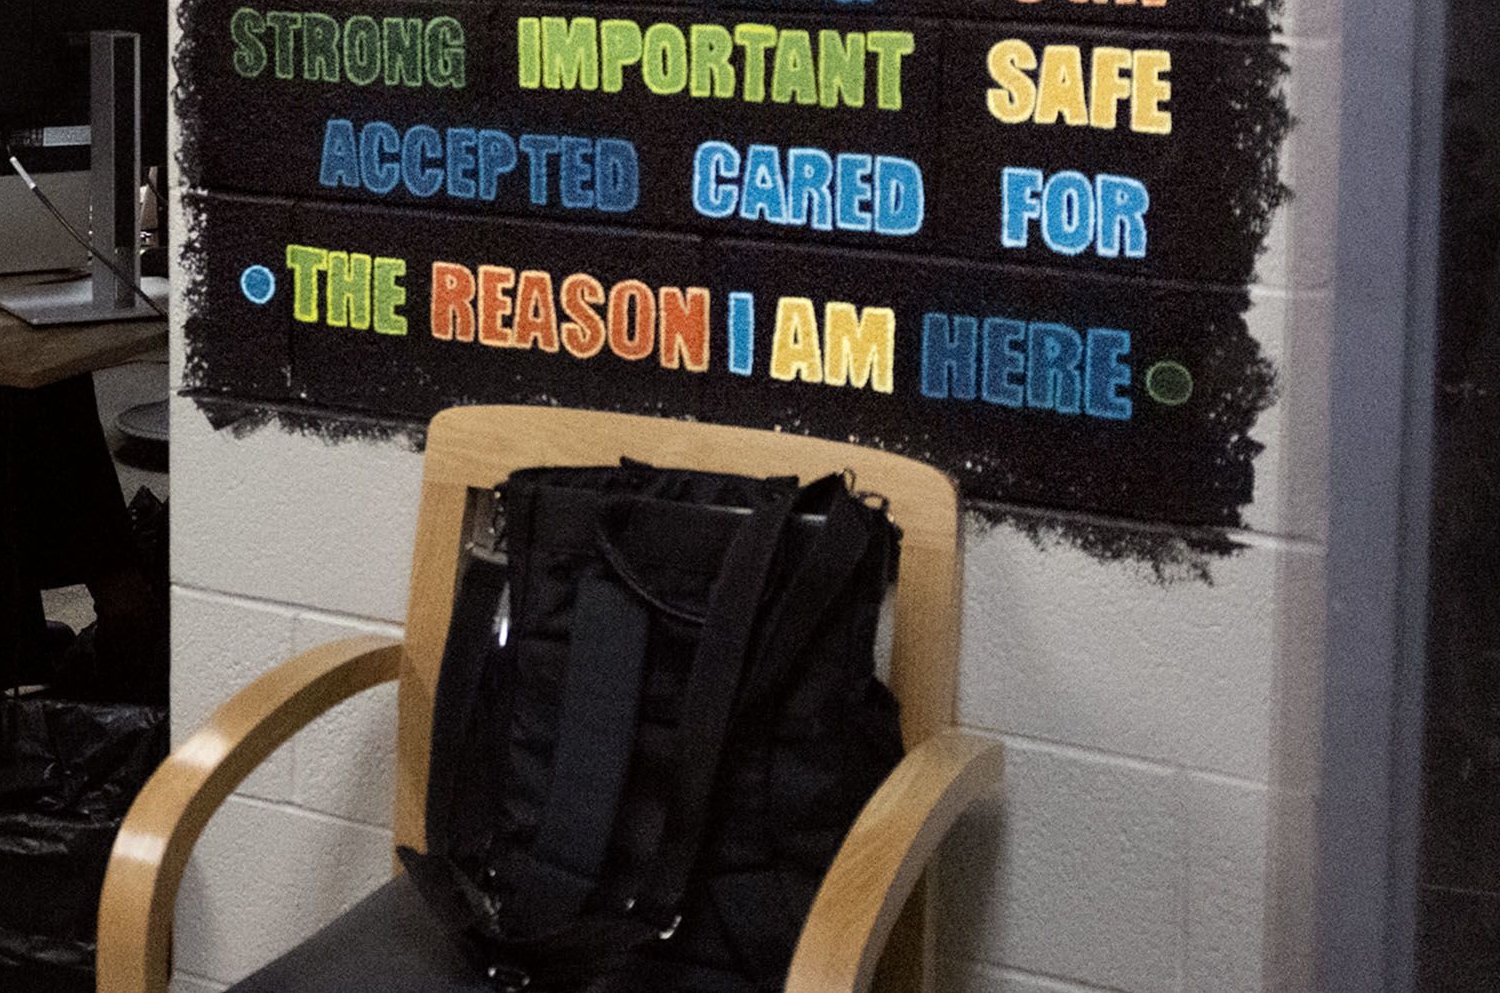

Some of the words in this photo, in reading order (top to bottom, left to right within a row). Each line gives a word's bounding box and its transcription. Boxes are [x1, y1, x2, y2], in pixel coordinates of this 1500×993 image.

[230, 7, 465, 89] STRONG
[518, 16, 915, 110] IMPORTANT
[987, 39, 1172, 134] SAFE
[319, 118, 639, 212] ACCEPTED
[692, 140, 925, 236] CARED
[1001, 167, 1149, 258] FOR
[286, 245, 407, 335] THE
[430, 261, 710, 372] REASON
[728, 291, 755, 376] I
[770, 297, 896, 393] AM
[920, 312, 1132, 420] HERE
